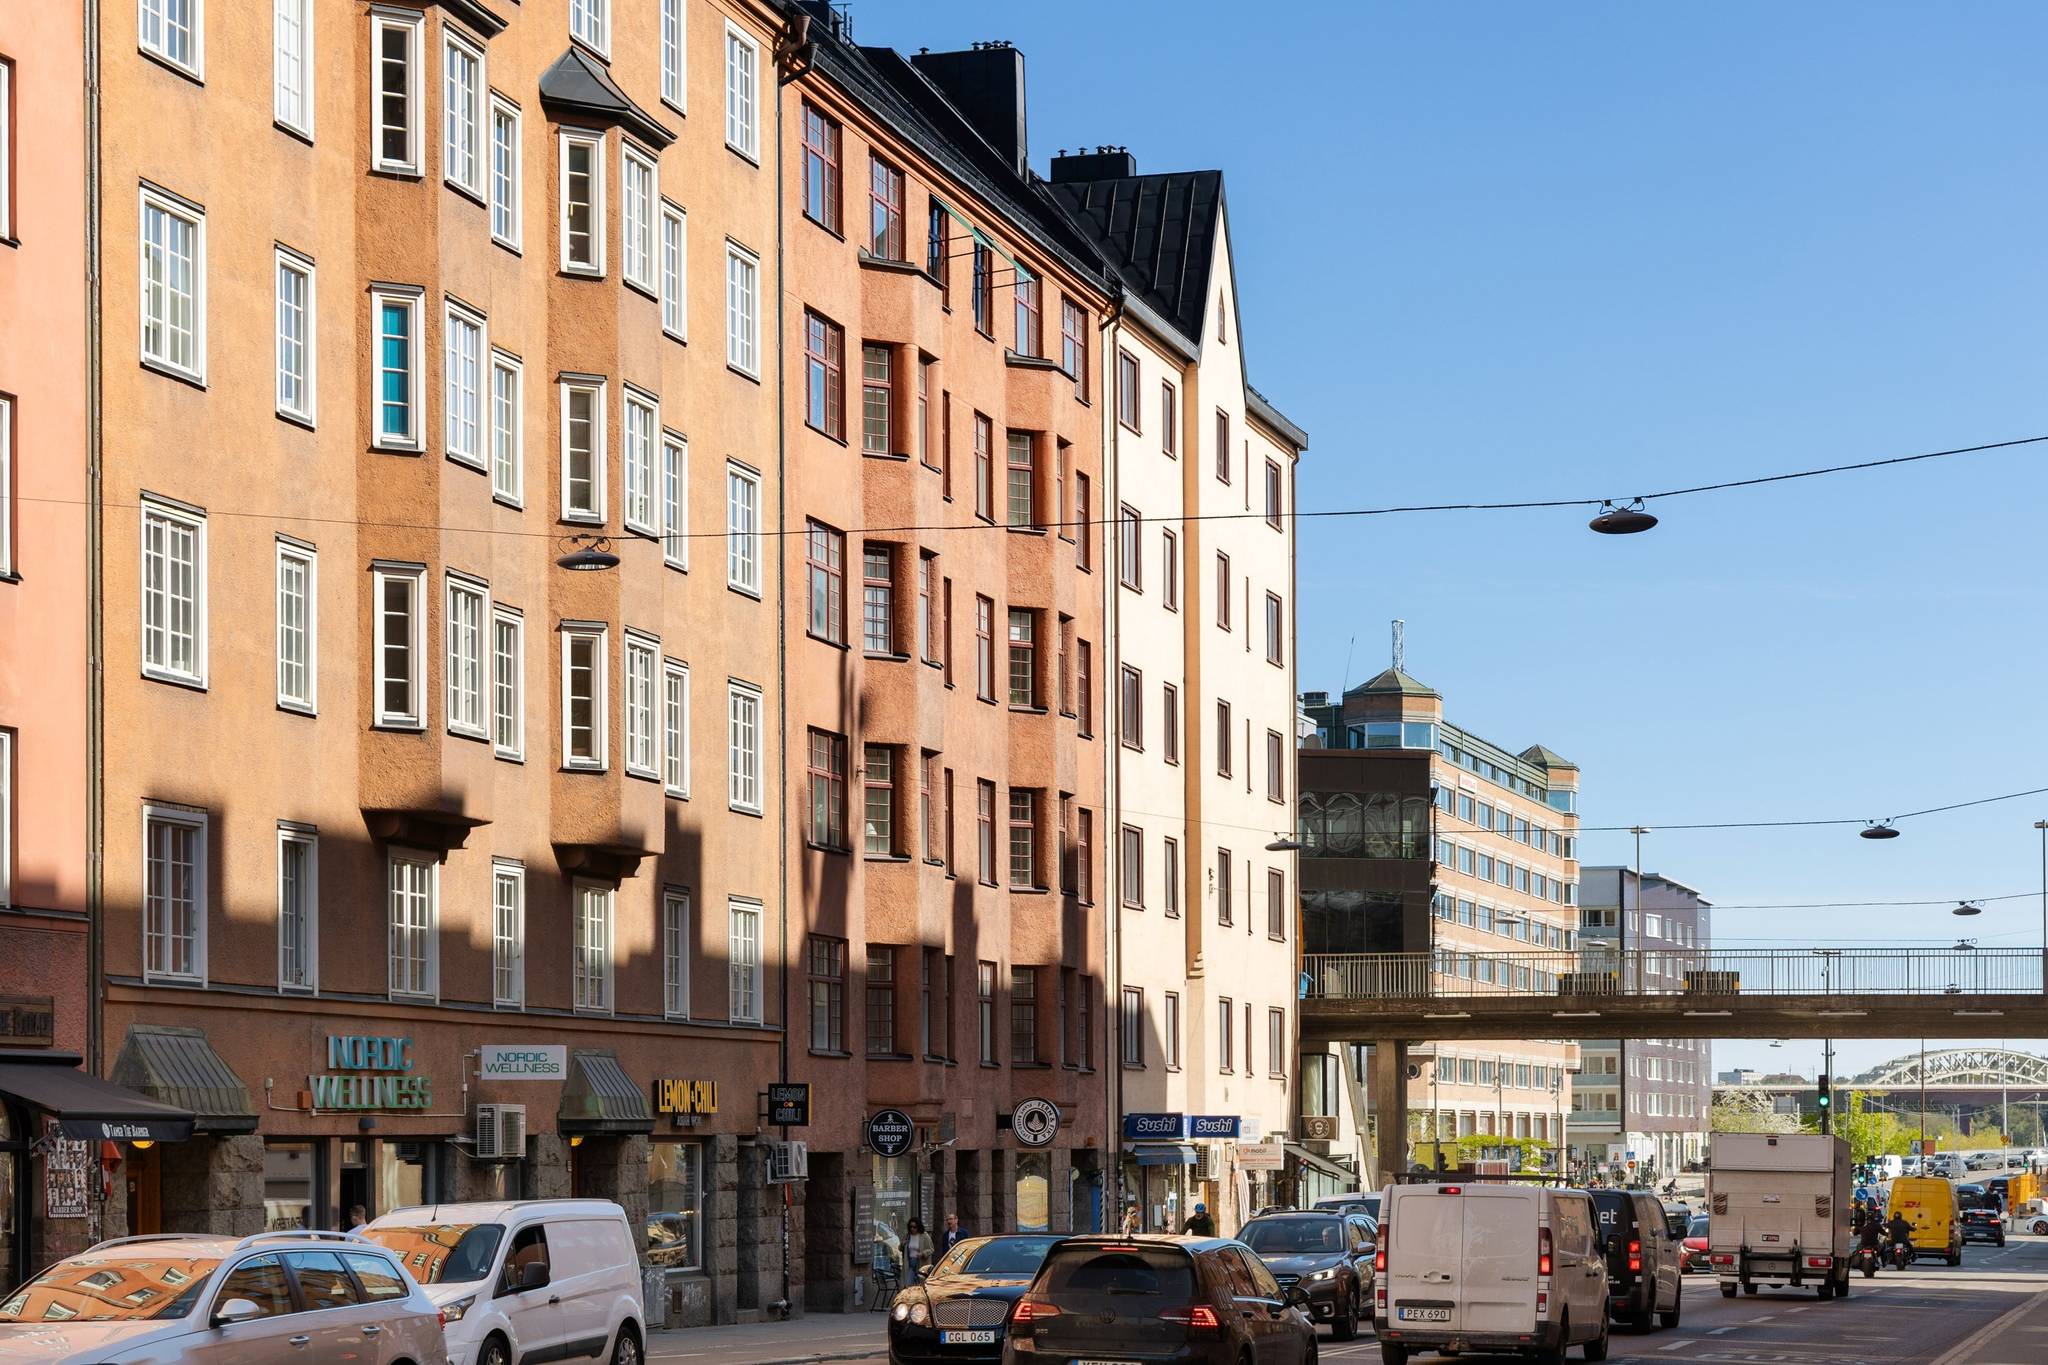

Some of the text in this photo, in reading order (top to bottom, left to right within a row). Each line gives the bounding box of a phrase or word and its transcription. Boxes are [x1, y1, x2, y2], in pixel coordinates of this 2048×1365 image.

[327, 1034, 414, 1071] NORDIC
[496, 1052, 548, 1063] NORDIC
[485, 1063, 560, 1073] WELLNESS
[308, 1075, 433, 1109] WELLNESS
[658, 1079, 691, 1113] LEMON
[695, 1080, 718, 1114] CHILI
[771, 1087, 806, 1101] LEMON
[775, 1108, 802, 1122] CHILI
[872, 1124, 908, 1132] BARBER
[1136, 1117, 1177, 1132] Sushi
[1196, 1118, 1233, 1132] Sushi
[878, 1134, 902, 1142] SHOP
[1407, 1309, 1446, 1319] PEX 690
[948, 1332, 990, 1342] CGL 065
